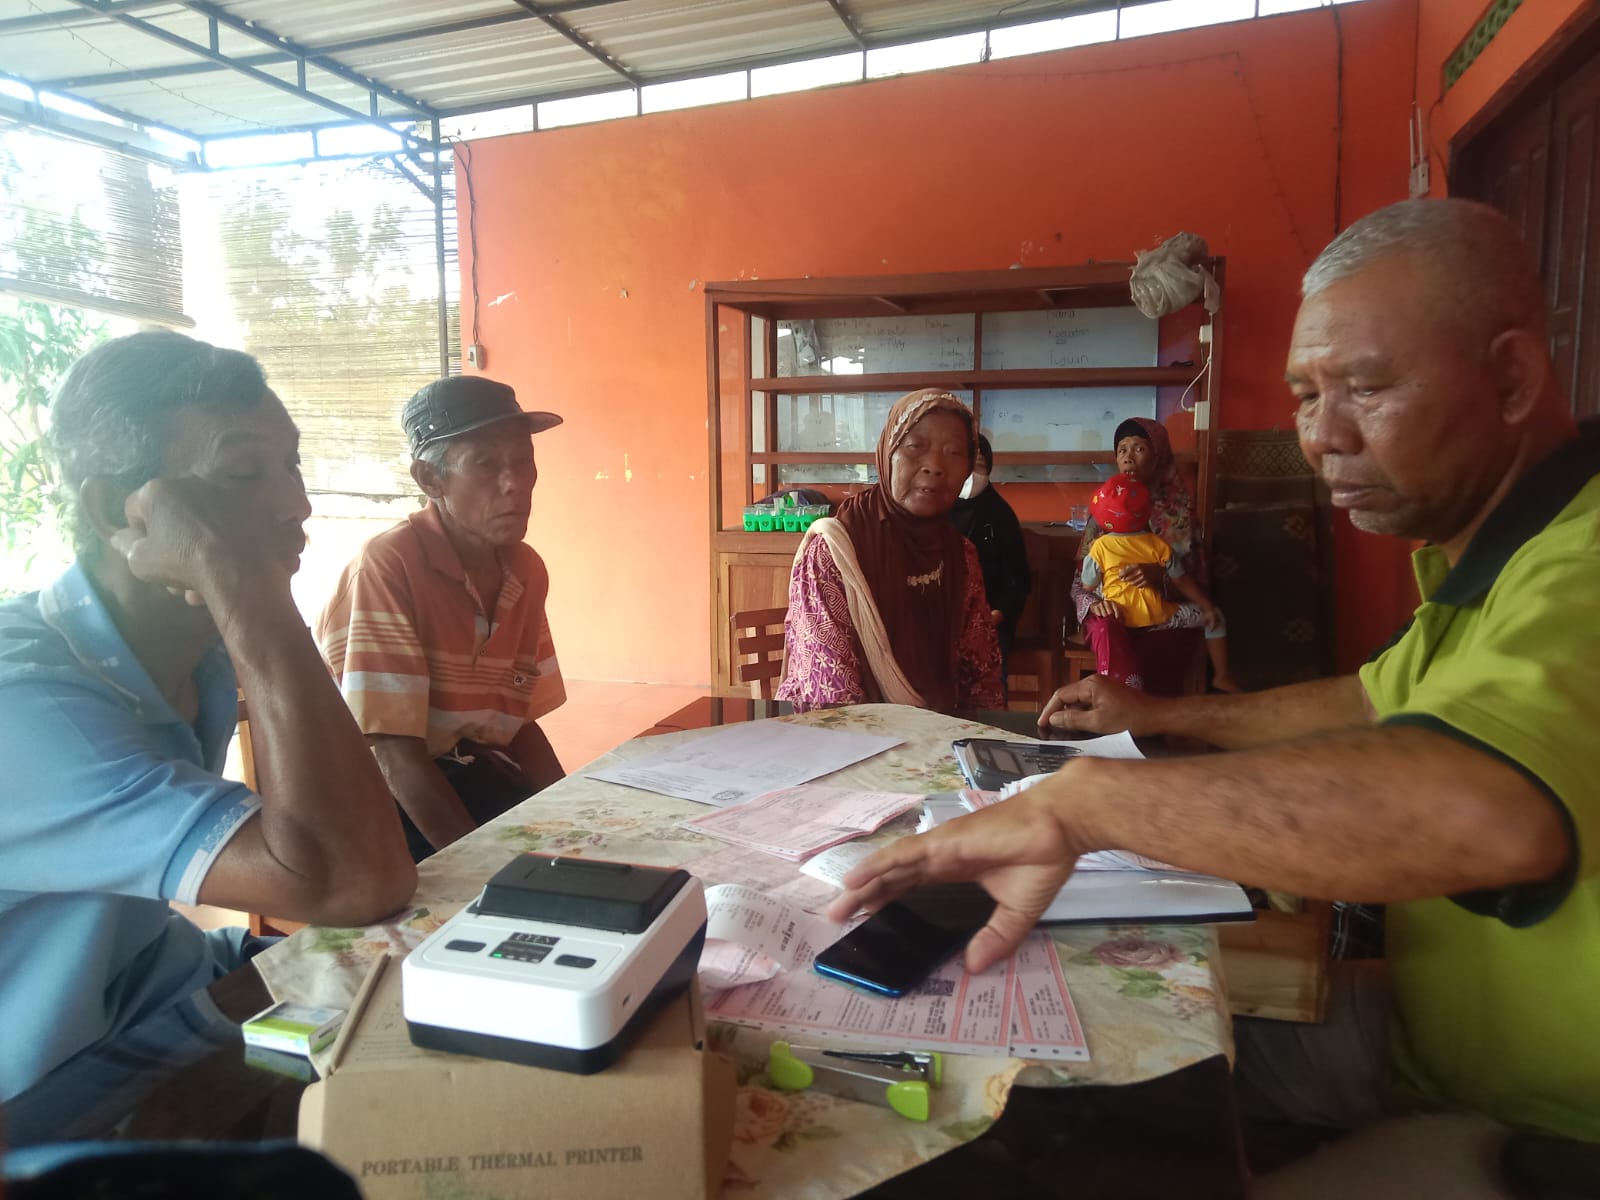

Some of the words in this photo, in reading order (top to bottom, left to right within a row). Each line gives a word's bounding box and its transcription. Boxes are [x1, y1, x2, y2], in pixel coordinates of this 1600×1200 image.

[361, 1156, 460, 1178] PORTABLE
[468, 1151, 557, 1171] THERMAL
[565, 1146, 643, 1166] PRINTER
